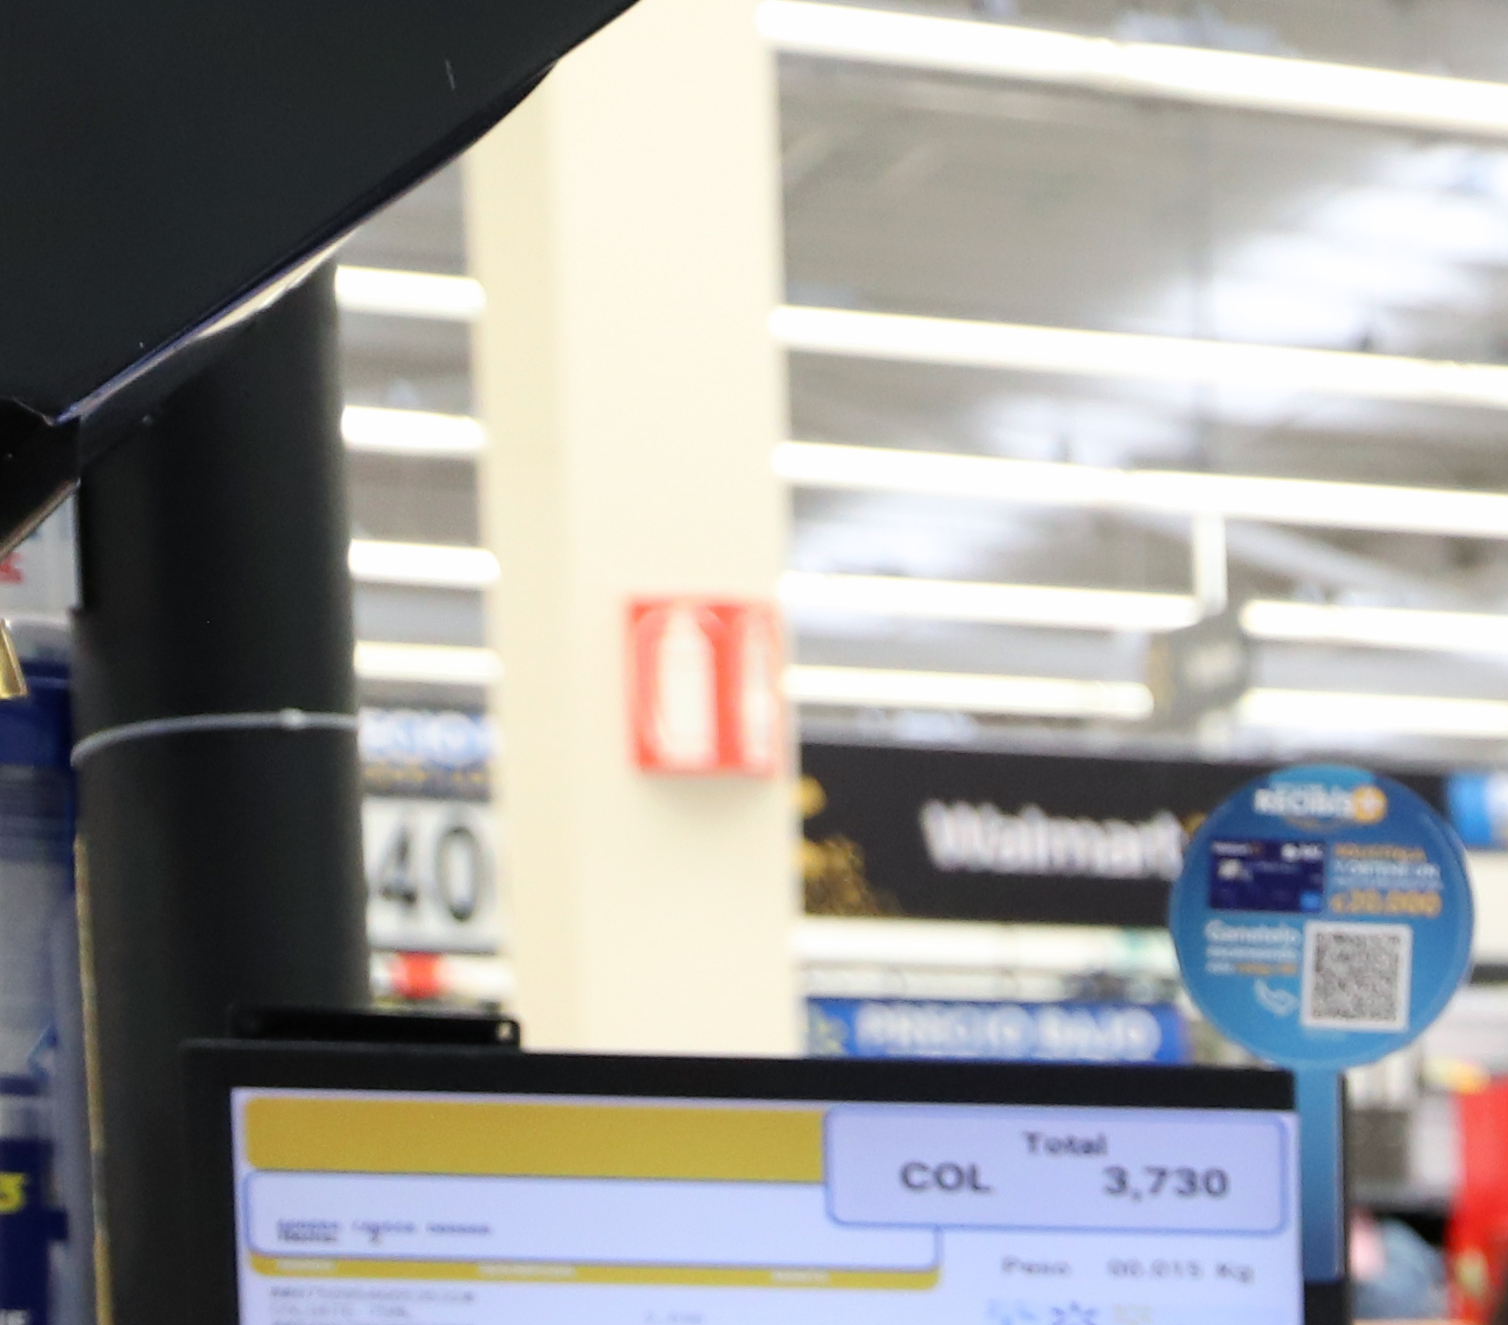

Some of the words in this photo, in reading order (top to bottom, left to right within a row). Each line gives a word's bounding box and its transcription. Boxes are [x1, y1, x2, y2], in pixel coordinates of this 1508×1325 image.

[920, 800, 1189, 878] Walmart
[1023, 1131, 1108, 1156] Total
[901, 1161, 993, 1194] COL
[1103, 1167, 1230, 1202] 3,730
